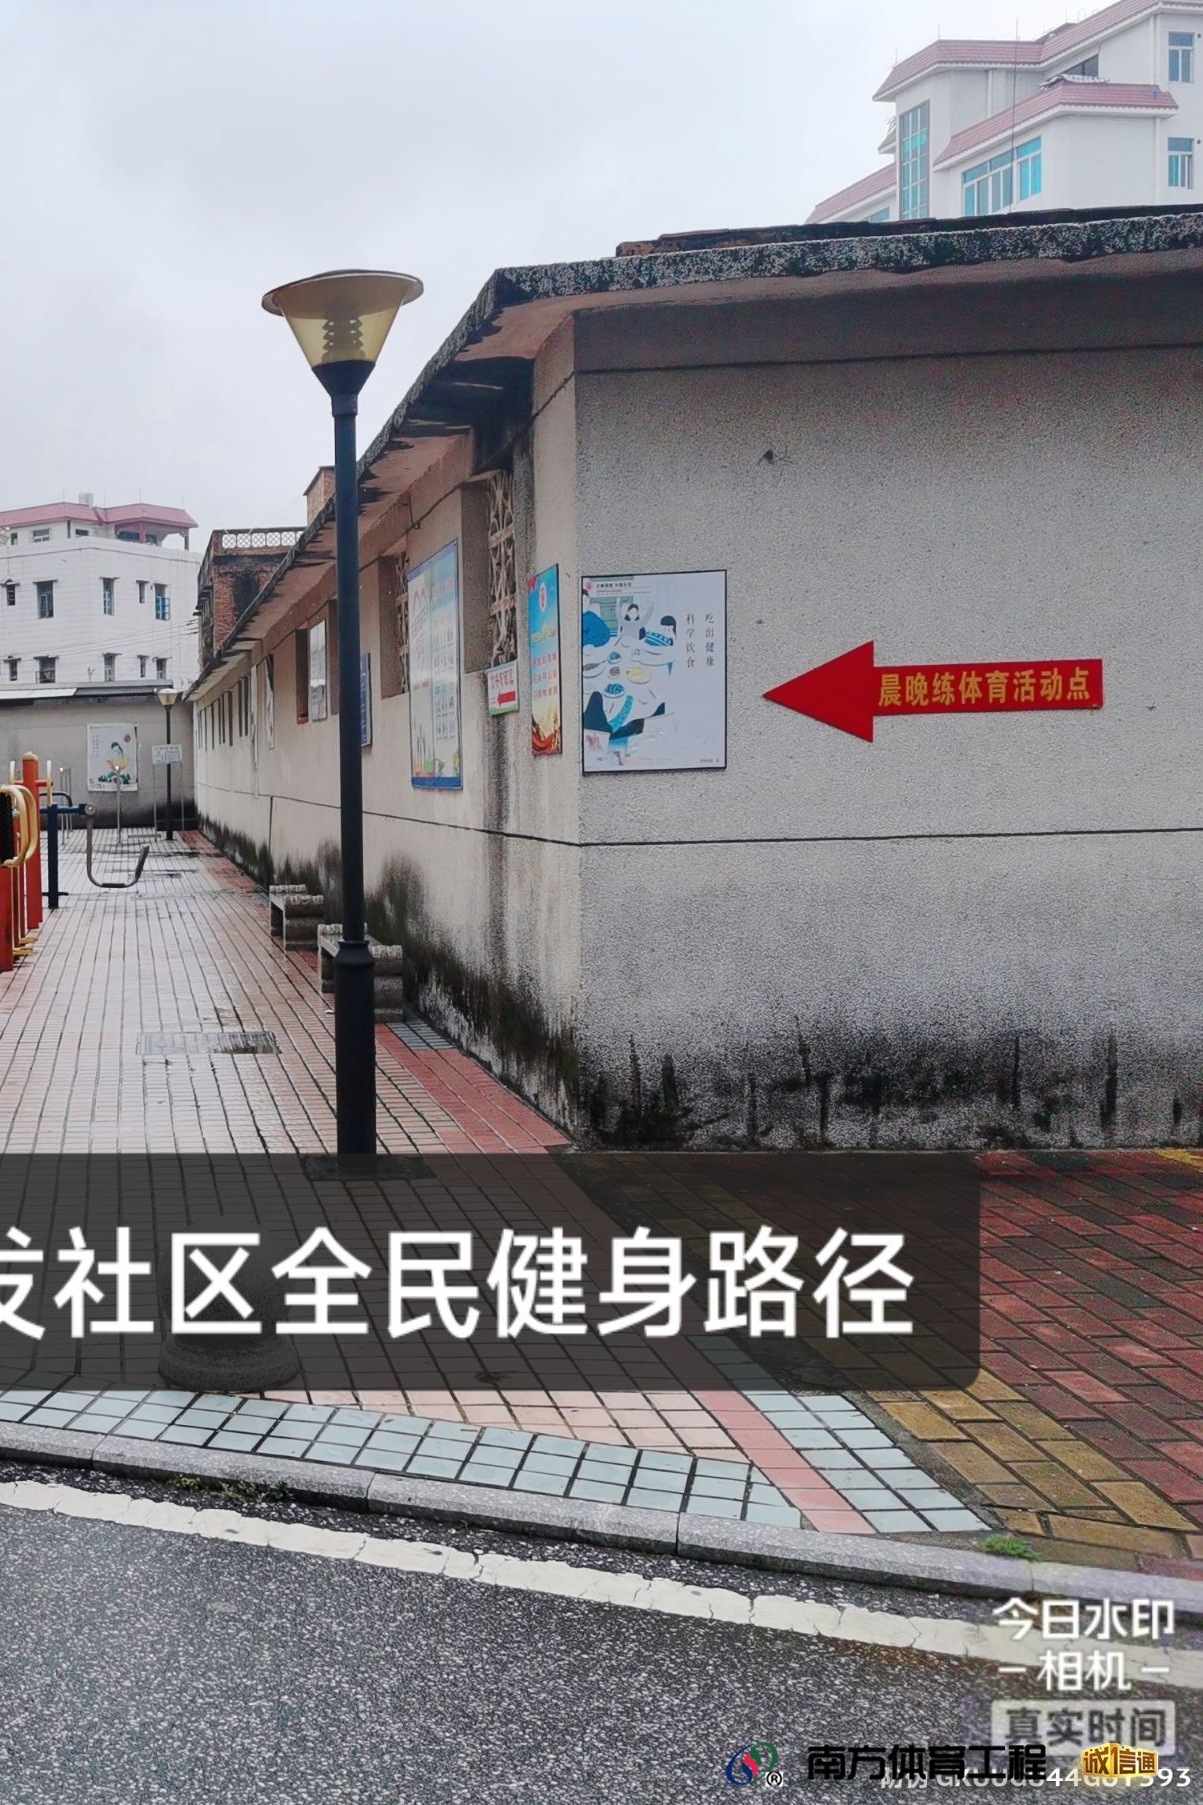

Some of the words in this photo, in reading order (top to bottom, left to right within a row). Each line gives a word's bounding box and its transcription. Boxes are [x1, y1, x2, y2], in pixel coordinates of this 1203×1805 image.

[878, 666, 1091, 707] 晨晚练体育活动点
